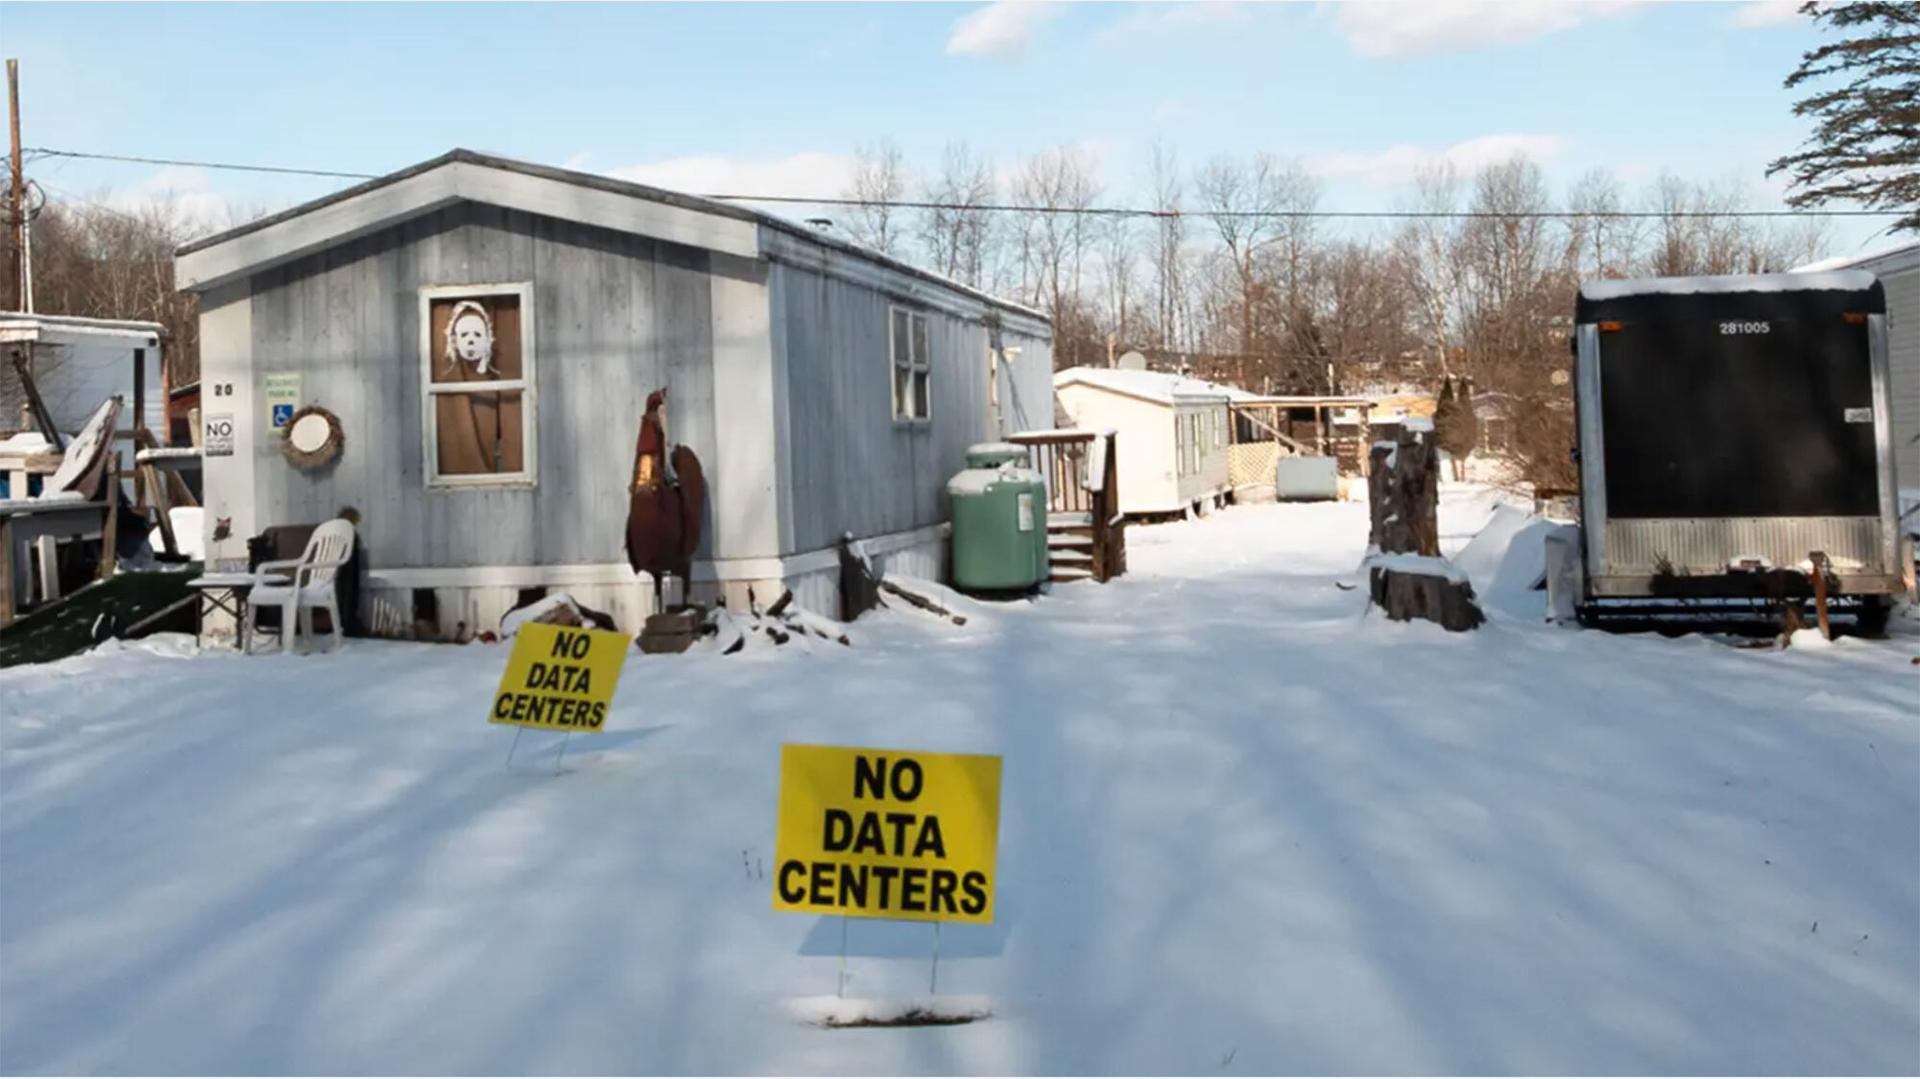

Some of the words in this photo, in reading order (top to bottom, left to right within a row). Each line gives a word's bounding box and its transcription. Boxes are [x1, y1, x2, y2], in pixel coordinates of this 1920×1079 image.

[1720, 321, 1770, 335] 281005
[215, 384, 232, 396] 20
[207, 422, 232, 436] NO
[551, 631, 591, 660] NO
[525, 662, 591, 694] DATA
[495, 692, 605, 728] CENTERS
[854, 755, 923, 803] NO
[823, 808, 946, 859] DATA
[778, 859, 987, 915] CENTERS
